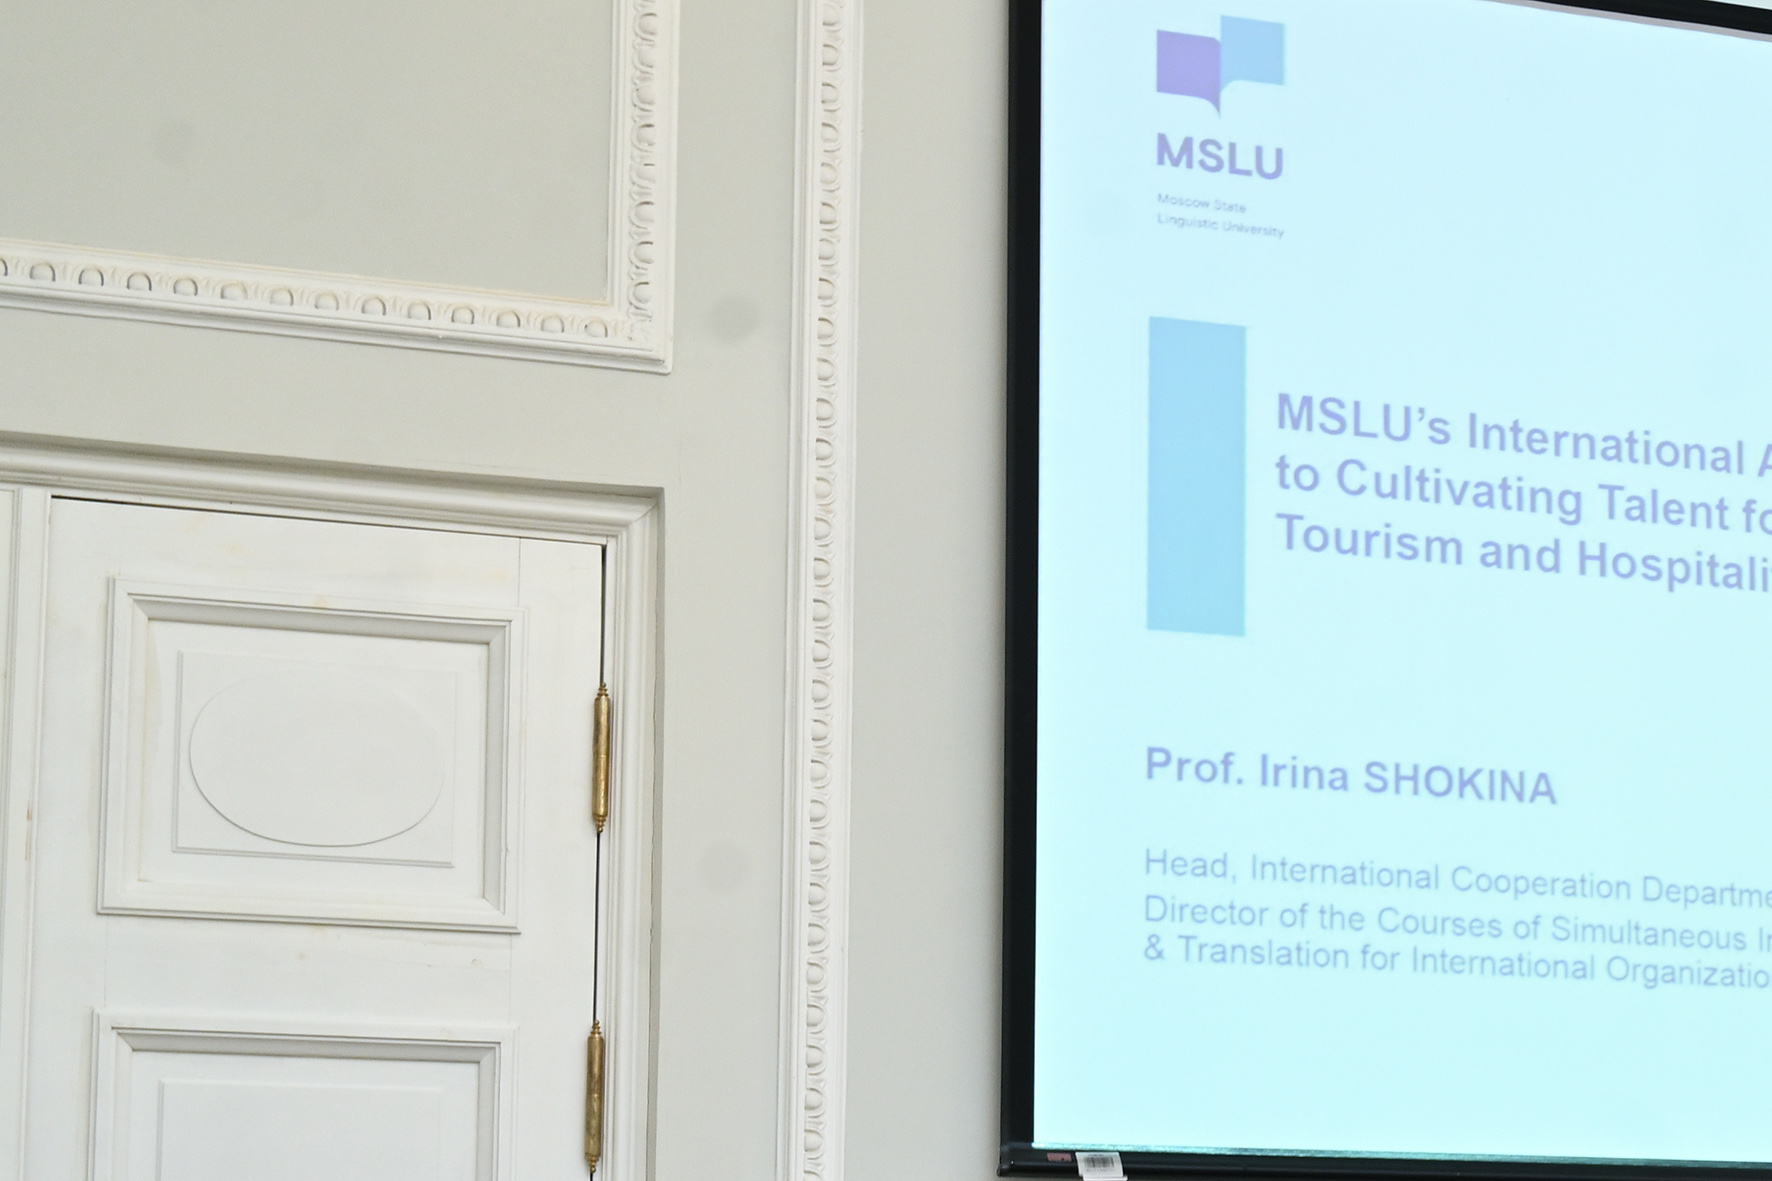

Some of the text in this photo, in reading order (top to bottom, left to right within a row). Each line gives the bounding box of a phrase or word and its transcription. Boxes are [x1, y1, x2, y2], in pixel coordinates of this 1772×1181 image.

[1156, 132, 1284, 180] MSLU
[1157, 193, 1247, 214] Moscow State
[1157, 213, 1285, 240] Linguistic University
[1469, 412, 1744, 475] International
[1275, 454, 1320, 492] to
[1336, 458, 1582, 526] Cultivating
[1597, 483, 1729, 532] Talent
[1275, 512, 1463, 566] Tourism
[1479, 534, 1561, 574] and
[1146, 746, 1558, 805] Prof. Irina SHOKINA
[1145, 847, 1237, 884] Head,
[1251, 853, 1440, 891] International
[1450, 864, 1632, 901] Cooperation
[1144, 893, 1269, 927] Director
[1278, 902, 1311, 929] of
[1318, 903, 1366, 933] the
[1377, 906, 1503, 939] Courses
[1512, 914, 1542, 941] of
[1551, 915, 1747, 952] Simultaneous
[1143, 933, 1166, 962] &
[1177, 934, 1350, 970] Translation
[1359, 942, 1400, 972] for
[1412, 945, 1596, 981] International
